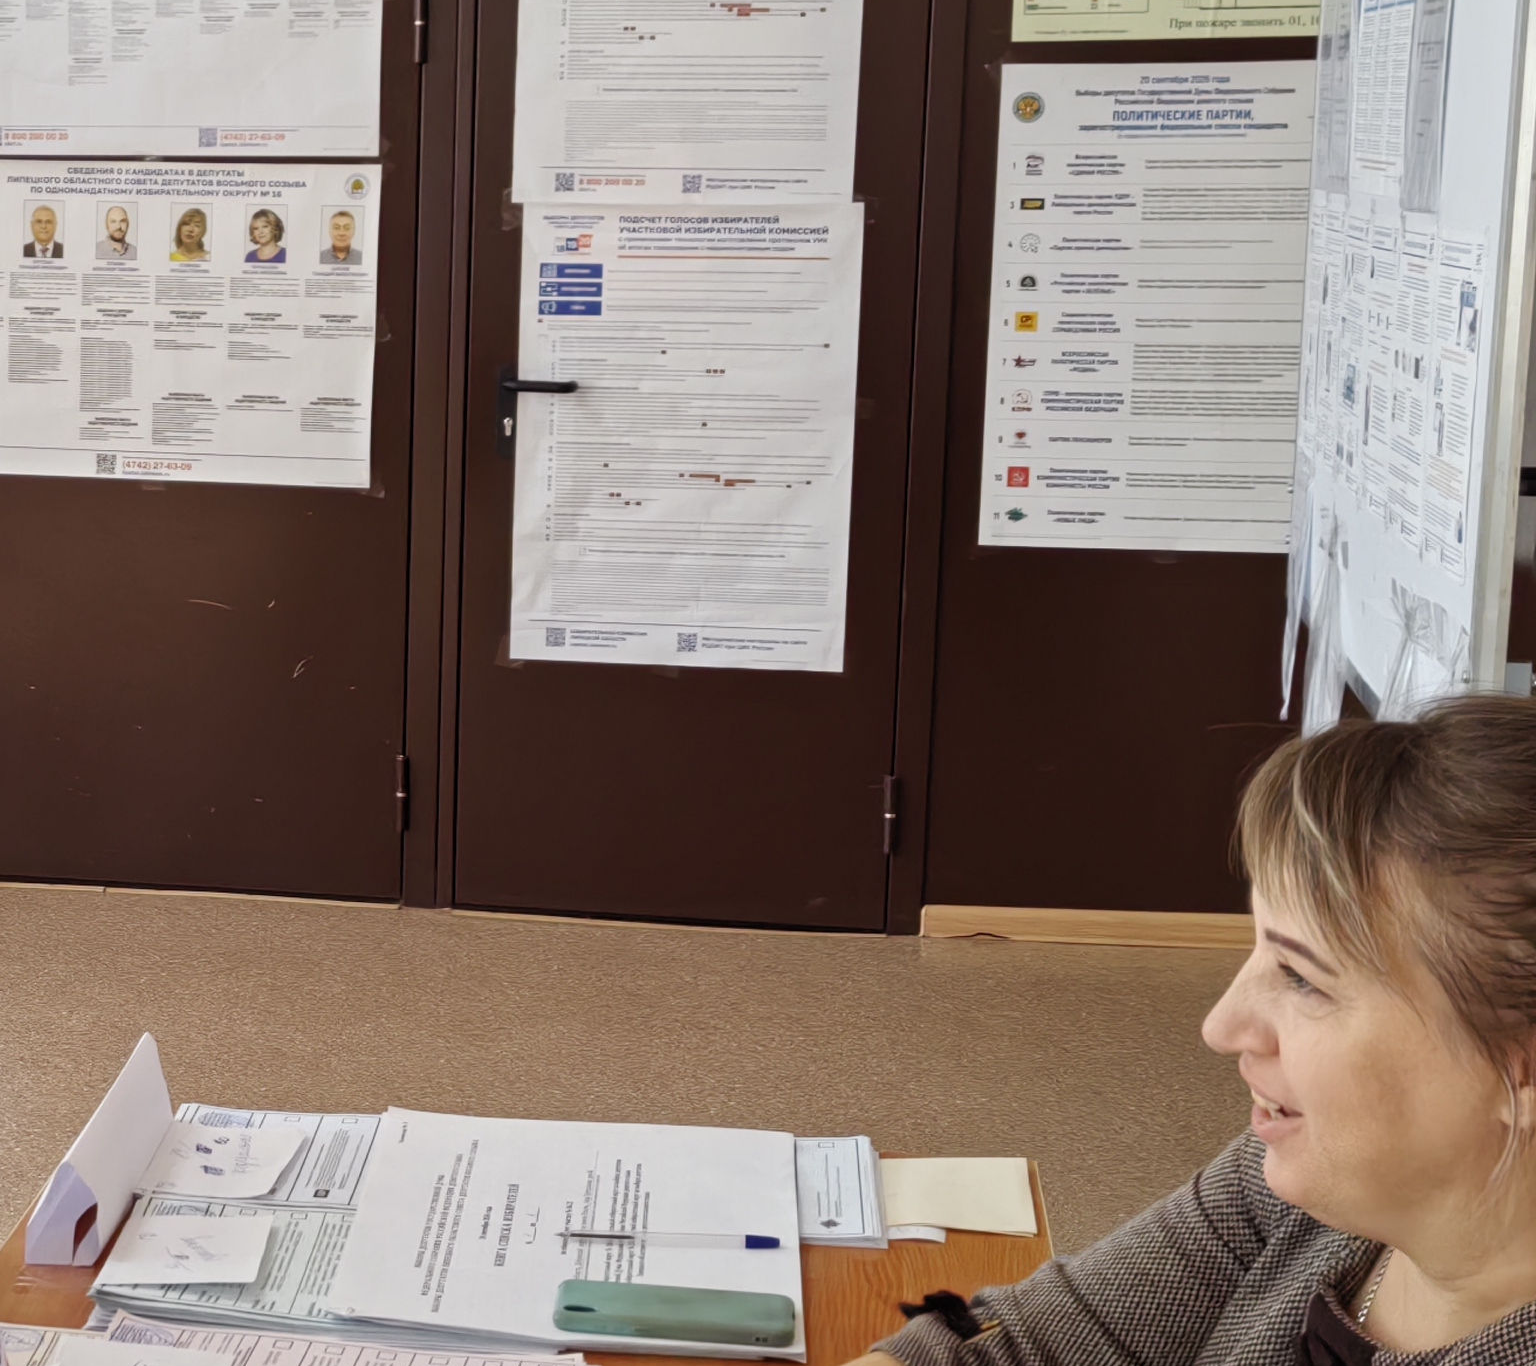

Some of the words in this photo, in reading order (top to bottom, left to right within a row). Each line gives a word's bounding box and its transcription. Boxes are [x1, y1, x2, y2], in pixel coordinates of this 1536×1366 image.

[1169, 18, 1192, 30] При
[1112, 110, 1203, 122] ПОЛИТИЧЕСКИЕ
[1206, 109, 1255, 122] ПАРТИИ,
[67, 167, 114, 175] СВЕДЕНИЯ
[125, 168, 185, 176] КАНДИДАТАХ
[196, 169, 244, 177] ДЕПУТАТЫ
[7, 176, 61, 184] ЛИПЕЦКОГО
[63, 176, 121, 185] ОБЛАСТНОГО
[161, 179, 214, 187] ДЕПУТАТОВ
[30, 186, 43, 194] ПО
[45, 187, 134, 195] ОДНОМАНДАТНОМУ
[136, 188, 220, 196] ИЗБИРАТЕЛЬНОМУ
[619, 216, 662, 224] ПОДСЧЕТ
[665, 216, 709, 225] ГОЛОСОВ
[711, 215, 780, 225] ИЗБИРАТЕЛЕЙ
[618, 225, 682, 235] УЧАСТКОВОЙ
[684, 225, 766, 235] ИЗБИРАТЕЛЬНОЙ
[768, 226, 829, 236] КОМИССИЕЙ
